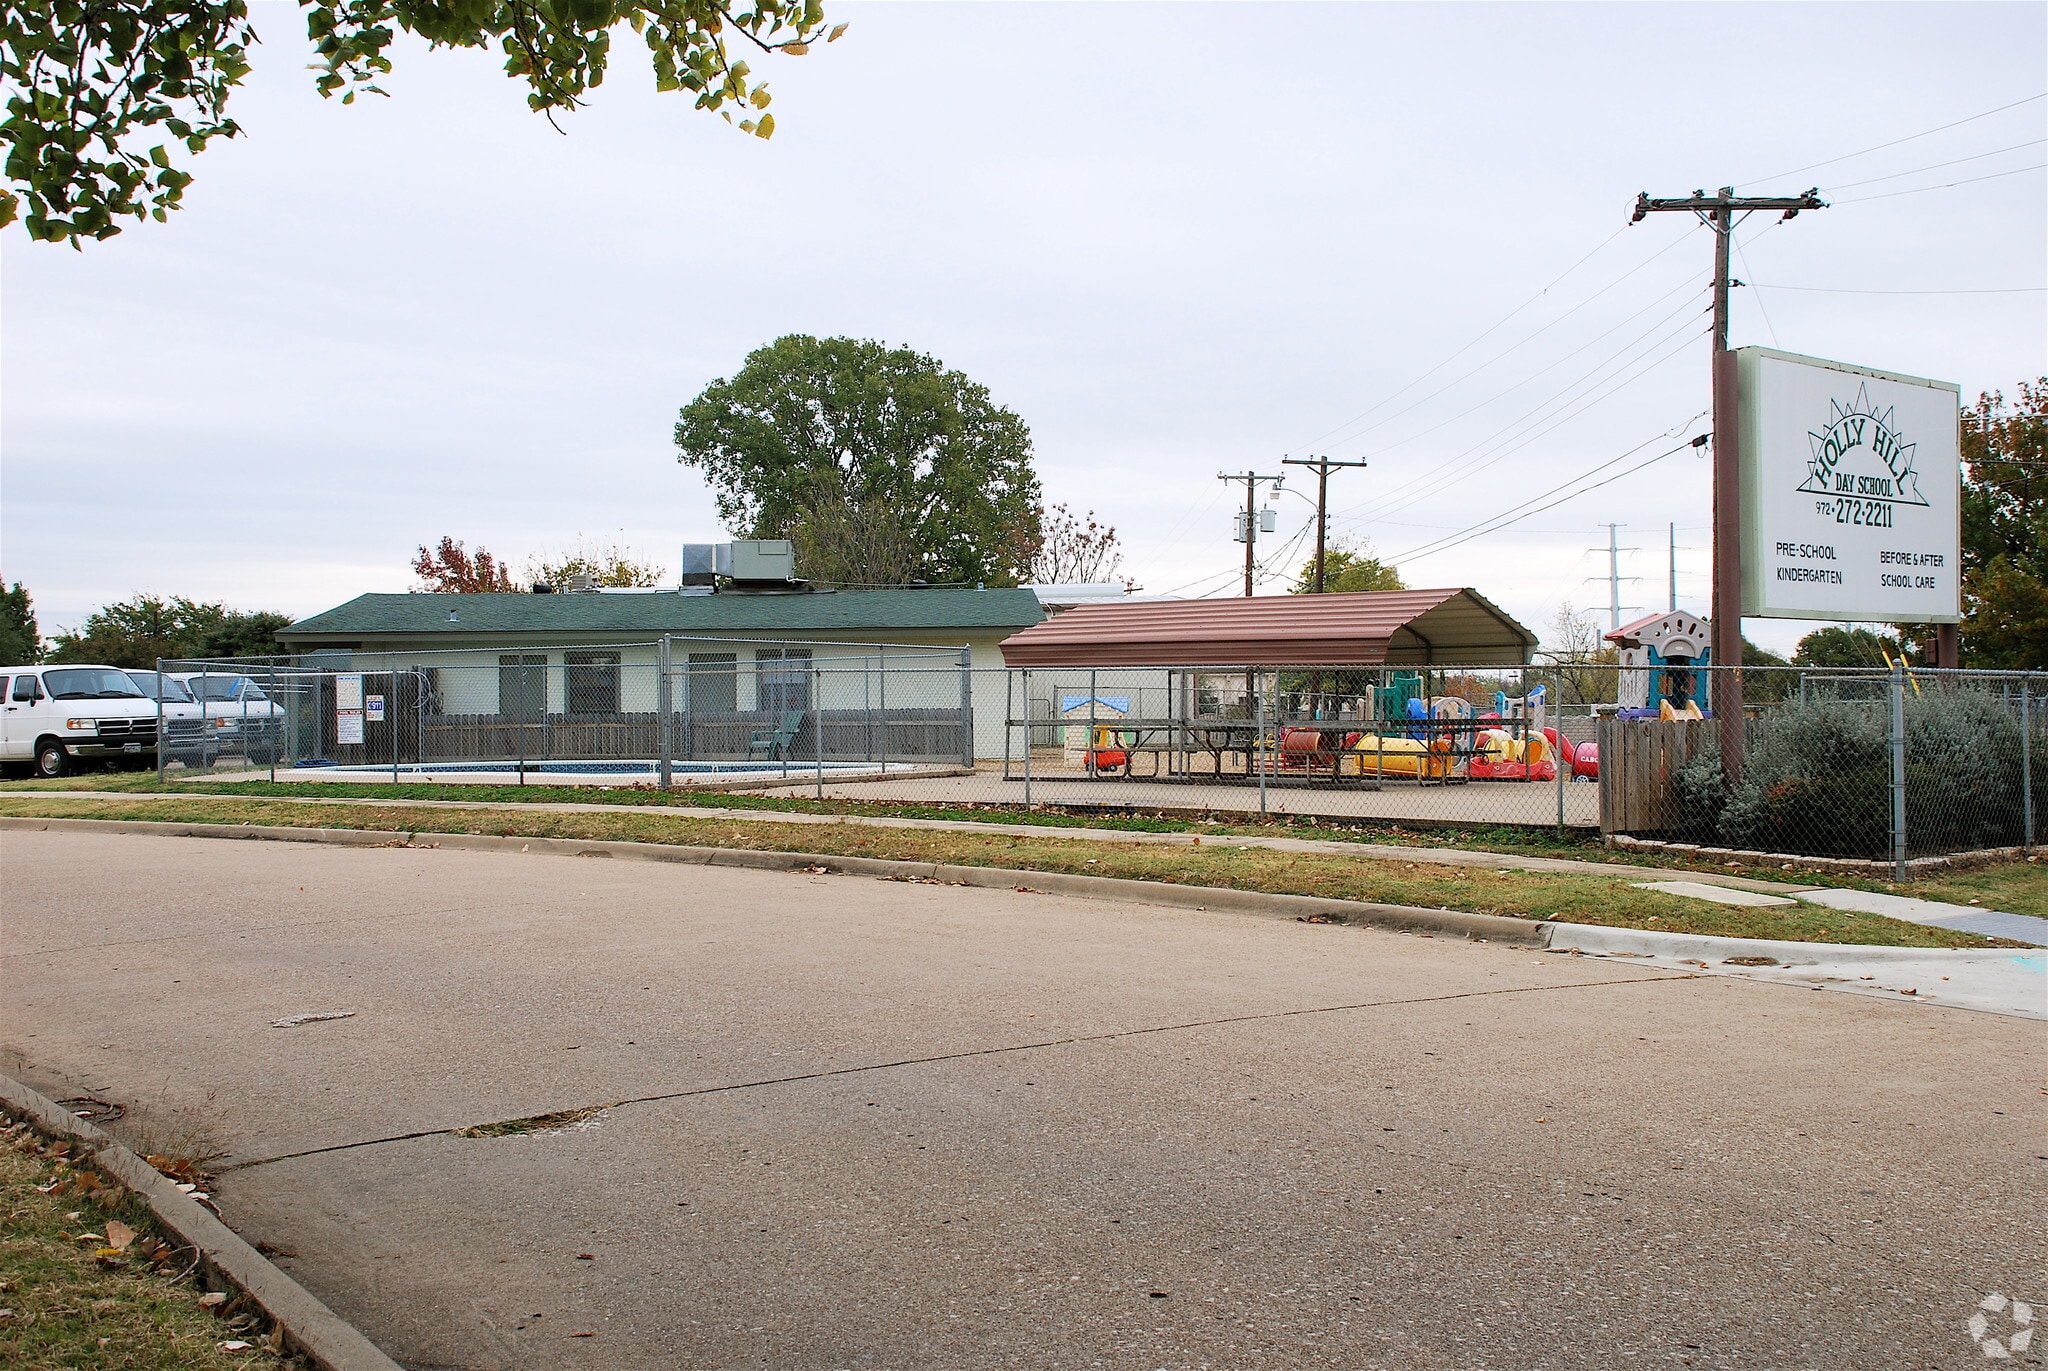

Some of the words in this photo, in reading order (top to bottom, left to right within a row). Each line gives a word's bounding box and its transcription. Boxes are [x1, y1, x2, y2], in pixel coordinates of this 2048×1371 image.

[1815, 418, 1866, 489] HOLLY
[1872, 425, 1909, 496] HILL
[1835, 472, 1855, 493] DAY
[1857, 475, 1894, 497] SCHOOL
[1776, 541, 1837, 560] PRE-SCHOOL
[1880, 551, 1912, 566] BEFORE
[1912, 553, 1919, 566] &
[1919, 554, 1944, 568] AFTER
[1776, 567, 1842, 585] KINDERGARTEN
[1880, 573, 1913, 588] SCHOOL
[1914, 575, 1935, 589] CARE
